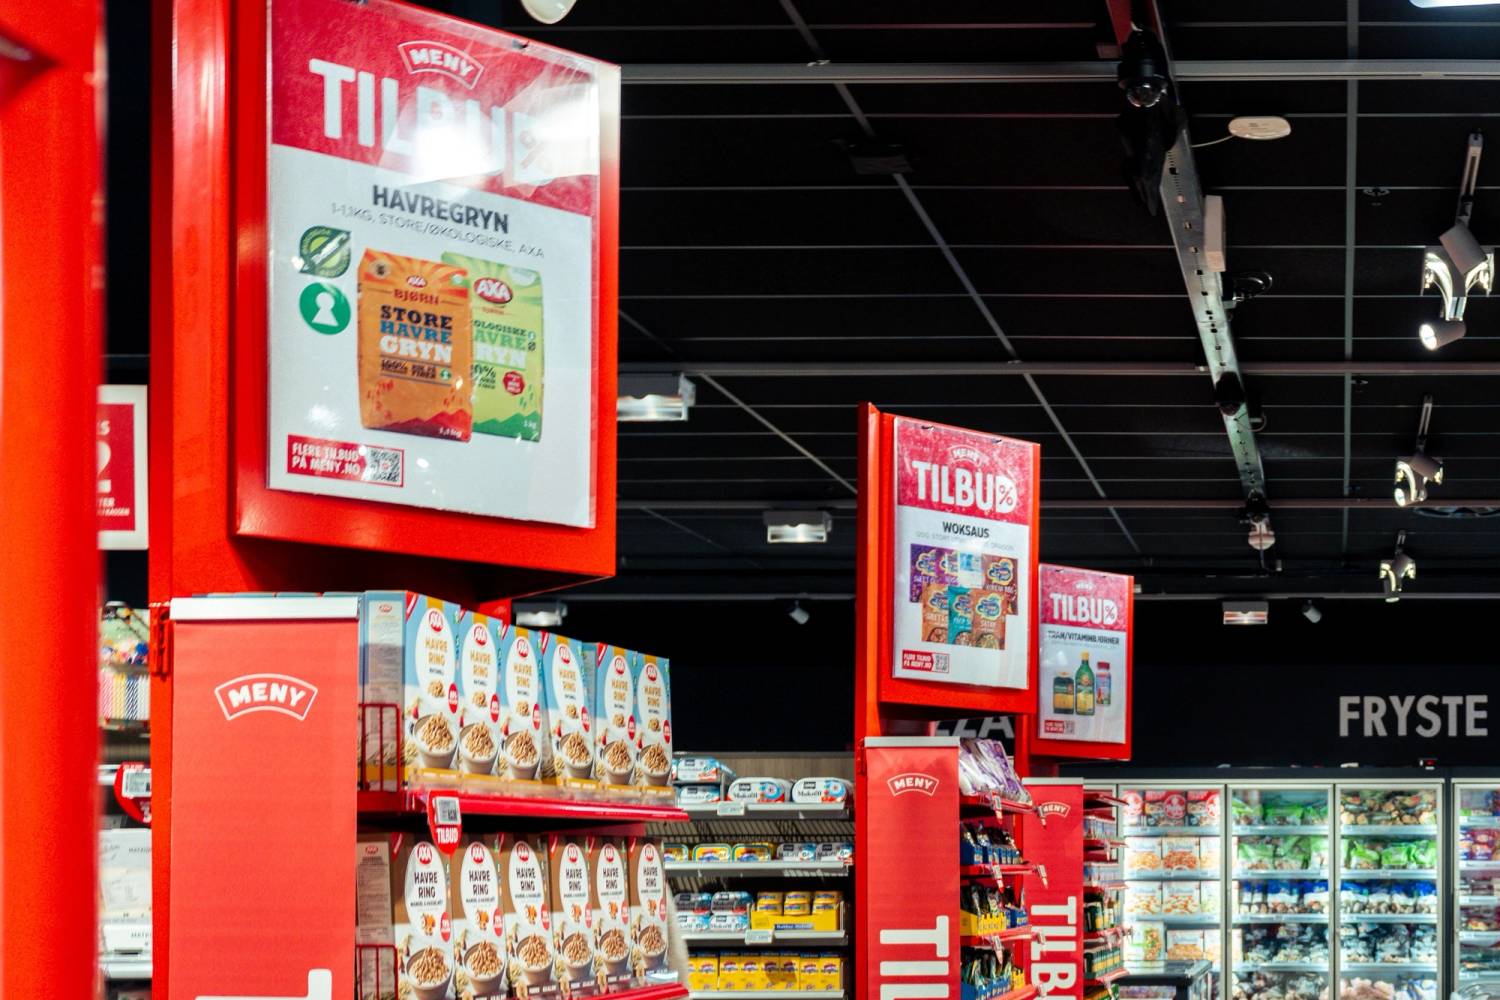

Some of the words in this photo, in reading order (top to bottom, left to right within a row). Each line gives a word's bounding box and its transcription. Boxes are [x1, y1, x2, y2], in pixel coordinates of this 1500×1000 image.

[409, 47, 474, 79] MENY
[372, 184, 510, 234] HAVREGRYN
[474, 279, 513, 302] AXA
[380, 305, 454, 329] STORE
[380, 320, 453, 344] HAVRE
[473, 319, 528, 337] OLOGISKE
[379, 335, 453, 363] GRYN
[473, 329, 527, 350] AVRE
[475, 343, 527, 369] RYN
[292, 442, 321, 457] FLERE
[323, 446, 360, 464] TILBUD
[292, 454, 309, 471] PÅ
[310, 457, 361, 476] MENY.NO
[911, 461, 1018, 513] TILBUD
[942, 521, 990, 539] WOKSAUS
[1050, 593, 1119, 626] TILBUD
[424, 637, 449, 652] HAVRE
[427, 652, 446, 665] RING
[228, 682, 306, 709] MENY
[1339, 694, 1489, 738] FRYSTE
[893, 777, 934, 791] MENY
[436, 829, 460, 844] TILBUD
[413, 871, 439, 886] HAVRE
[468, 869, 491, 884] HAVRE
[515, 867, 537, 880] HAVRE
[417, 885, 437, 899] RING
[471, 881, 489, 895] RING
[519, 879, 537, 892] RING
